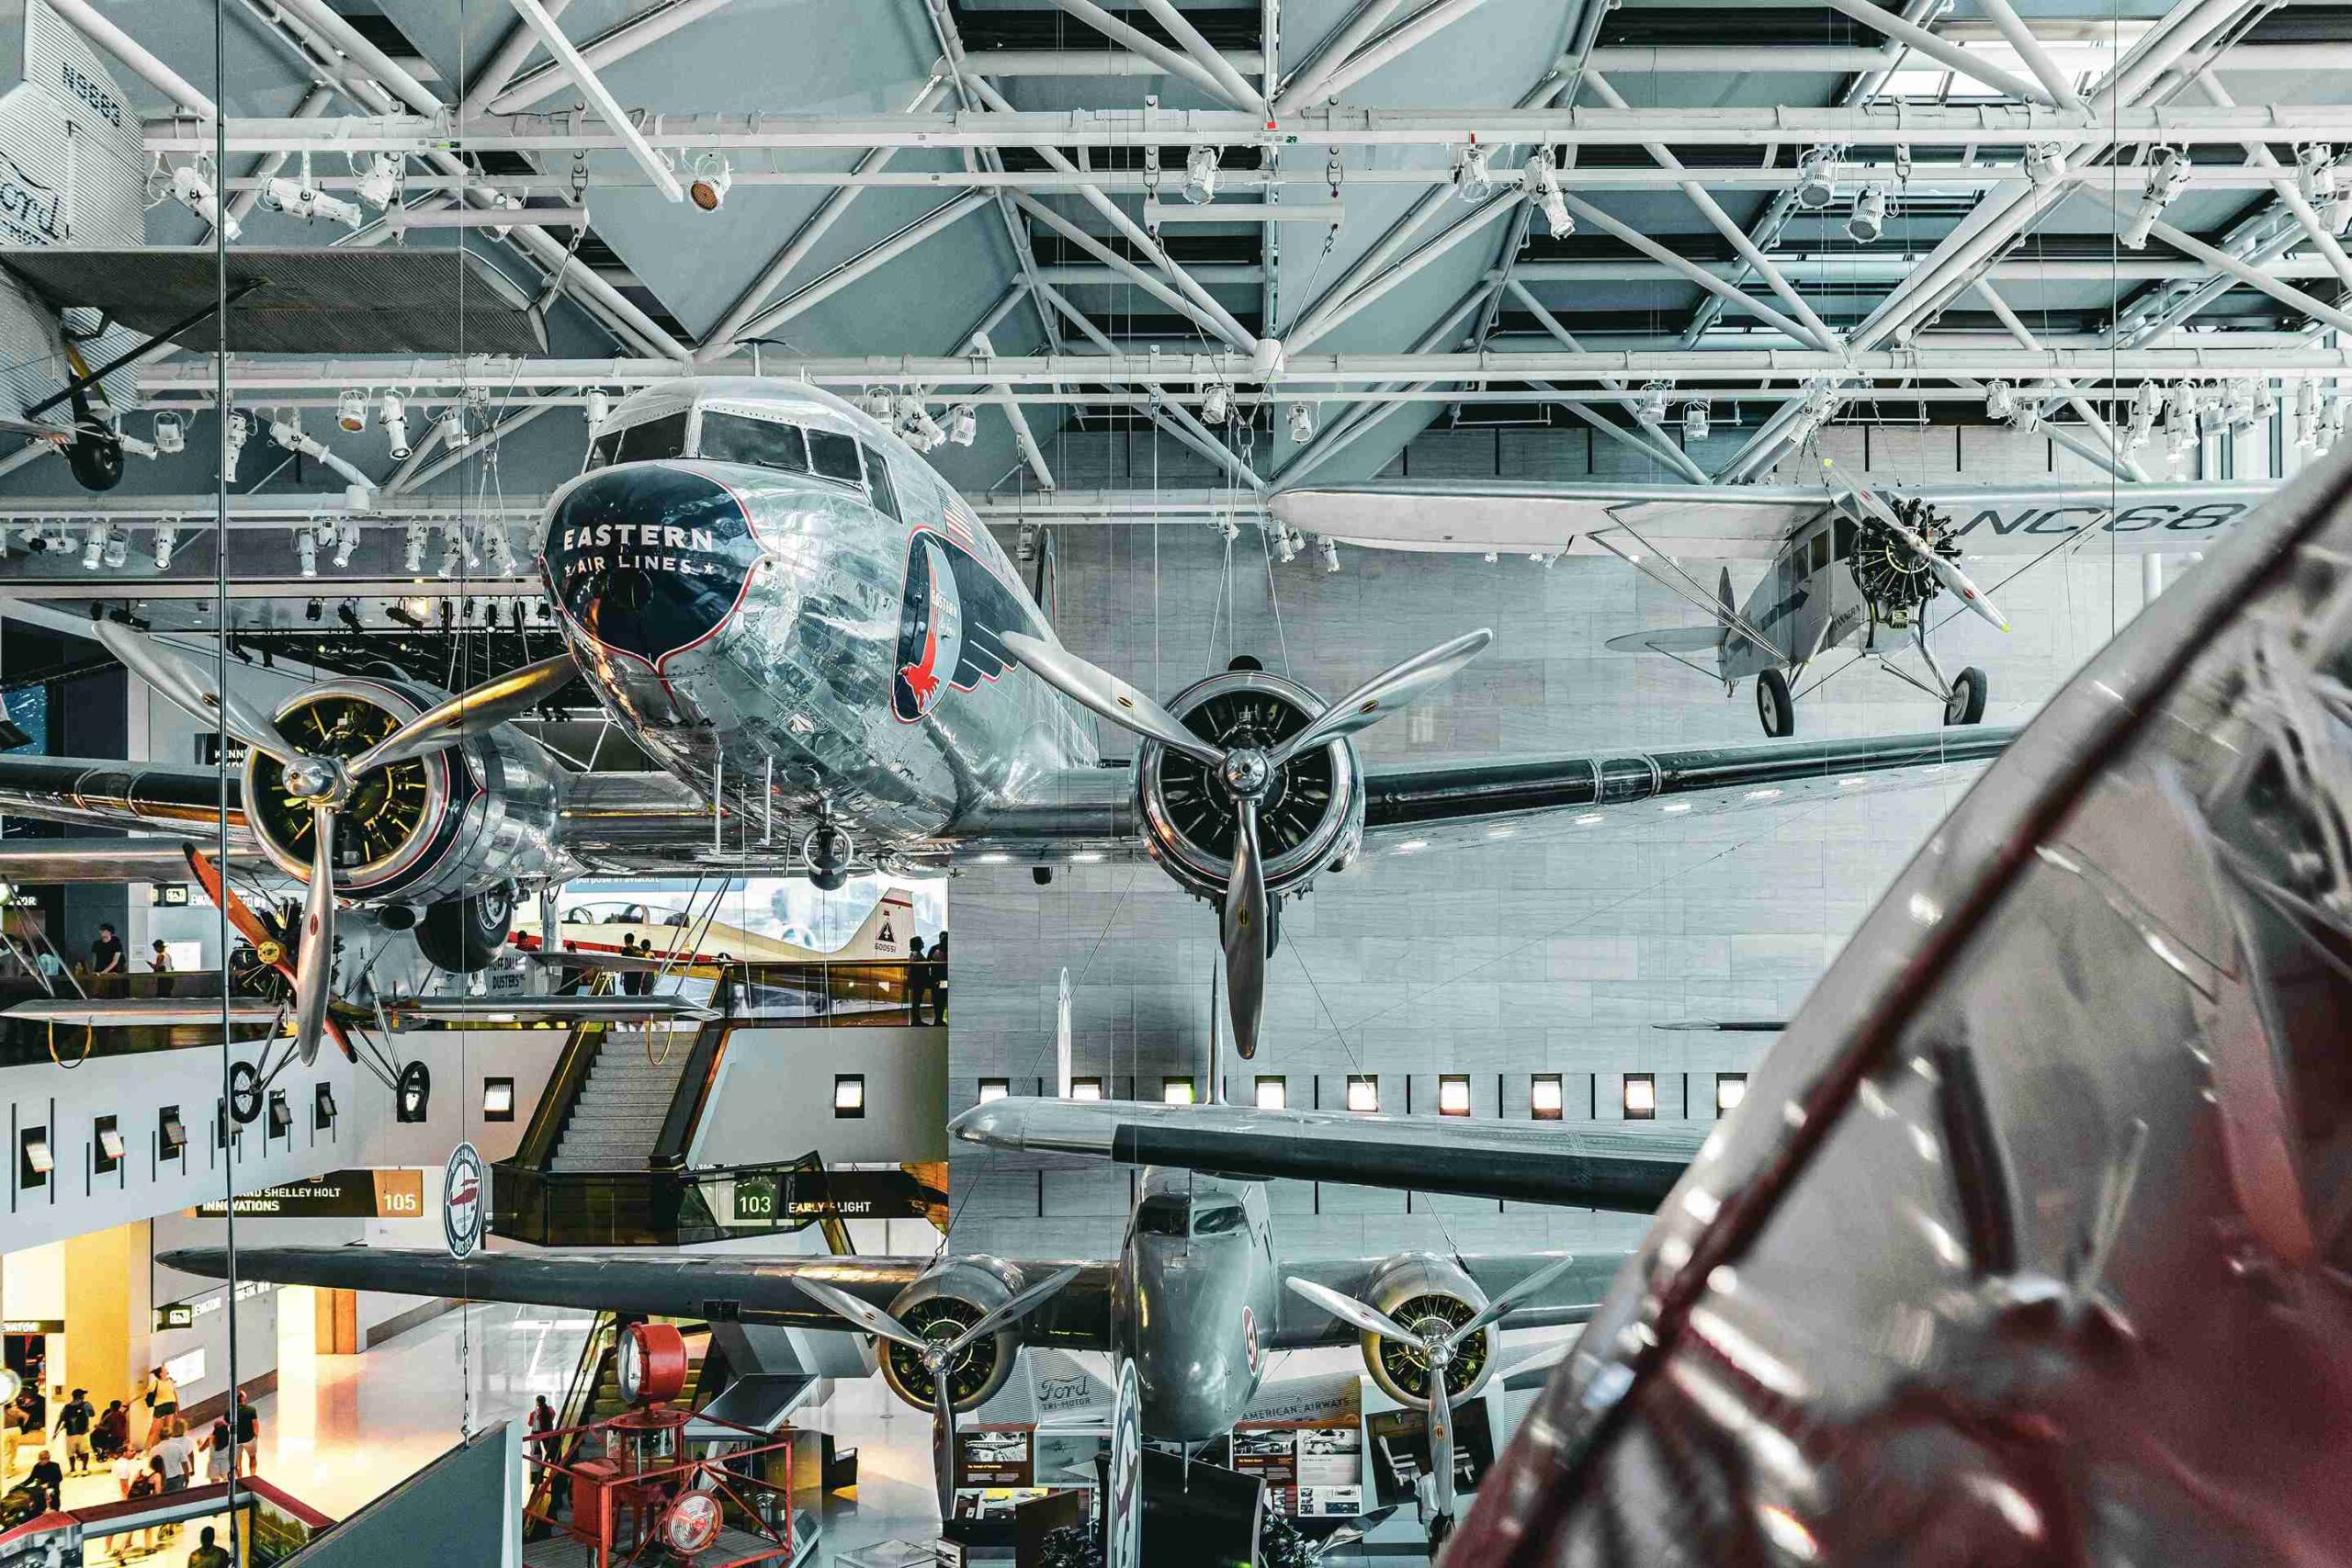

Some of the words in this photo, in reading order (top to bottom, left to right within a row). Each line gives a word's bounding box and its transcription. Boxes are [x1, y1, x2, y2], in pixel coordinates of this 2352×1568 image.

[1957, 503, 2248, 537] NC68
[564, 524, 712, 551] EASTERN
[578, 556, 606, 574] AIR
[618, 555, 692, 575] LINES
[264, 1187, 311, 1198] SHELLEY
[313, 1187, 341, 1198] HOLT
[383, 1193, 416, 1211] 105
[739, 1196, 772, 1213] 103
[788, 1201, 825, 1213] EARLY
[1038, 1375, 1090, 1401] Ford
[1242, 1404, 1299, 1420] AMERICAN
[1304, 1396, 1350, 1412] AIRWAYS
